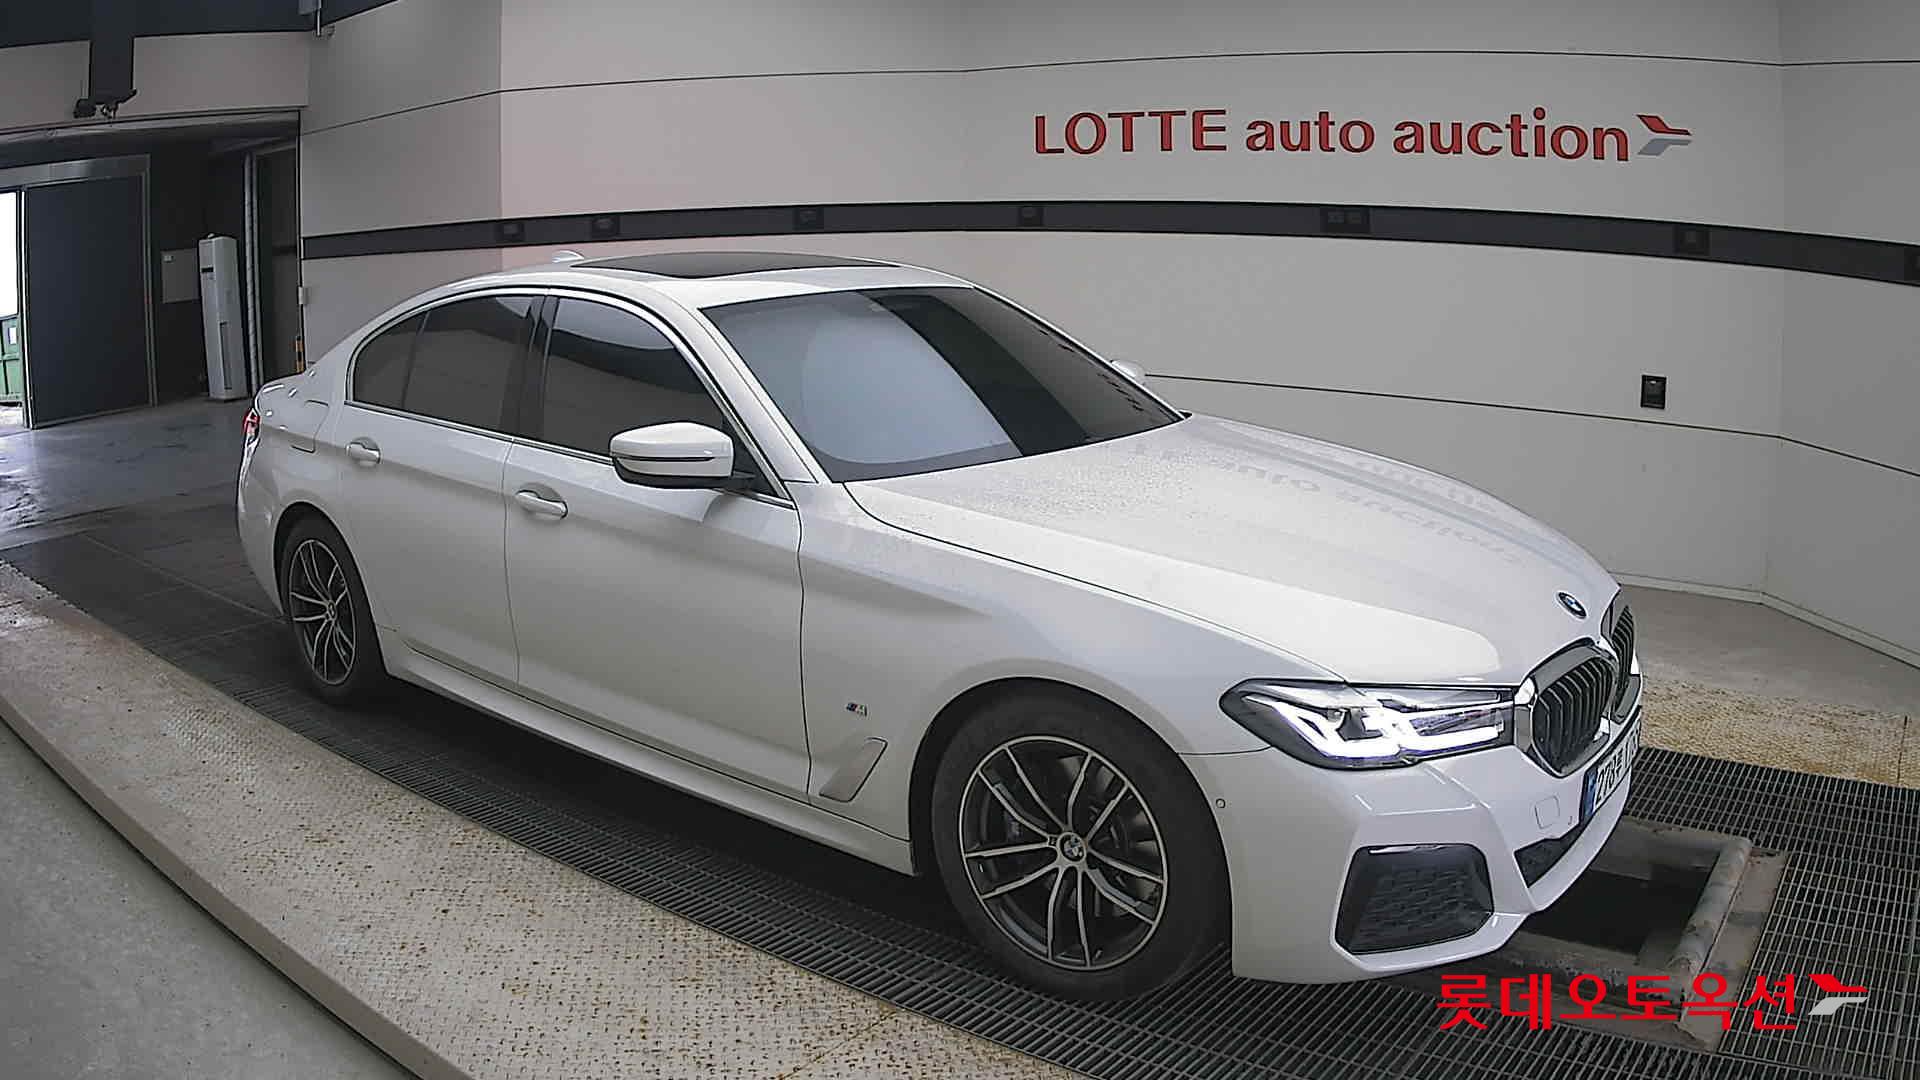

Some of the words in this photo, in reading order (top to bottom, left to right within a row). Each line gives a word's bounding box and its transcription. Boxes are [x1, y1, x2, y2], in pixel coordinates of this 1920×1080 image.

[1034, 109, 1227, 156] LOTTE
[1245, 110, 1376, 154] auto
[1393, 106, 1630, 162] auction
